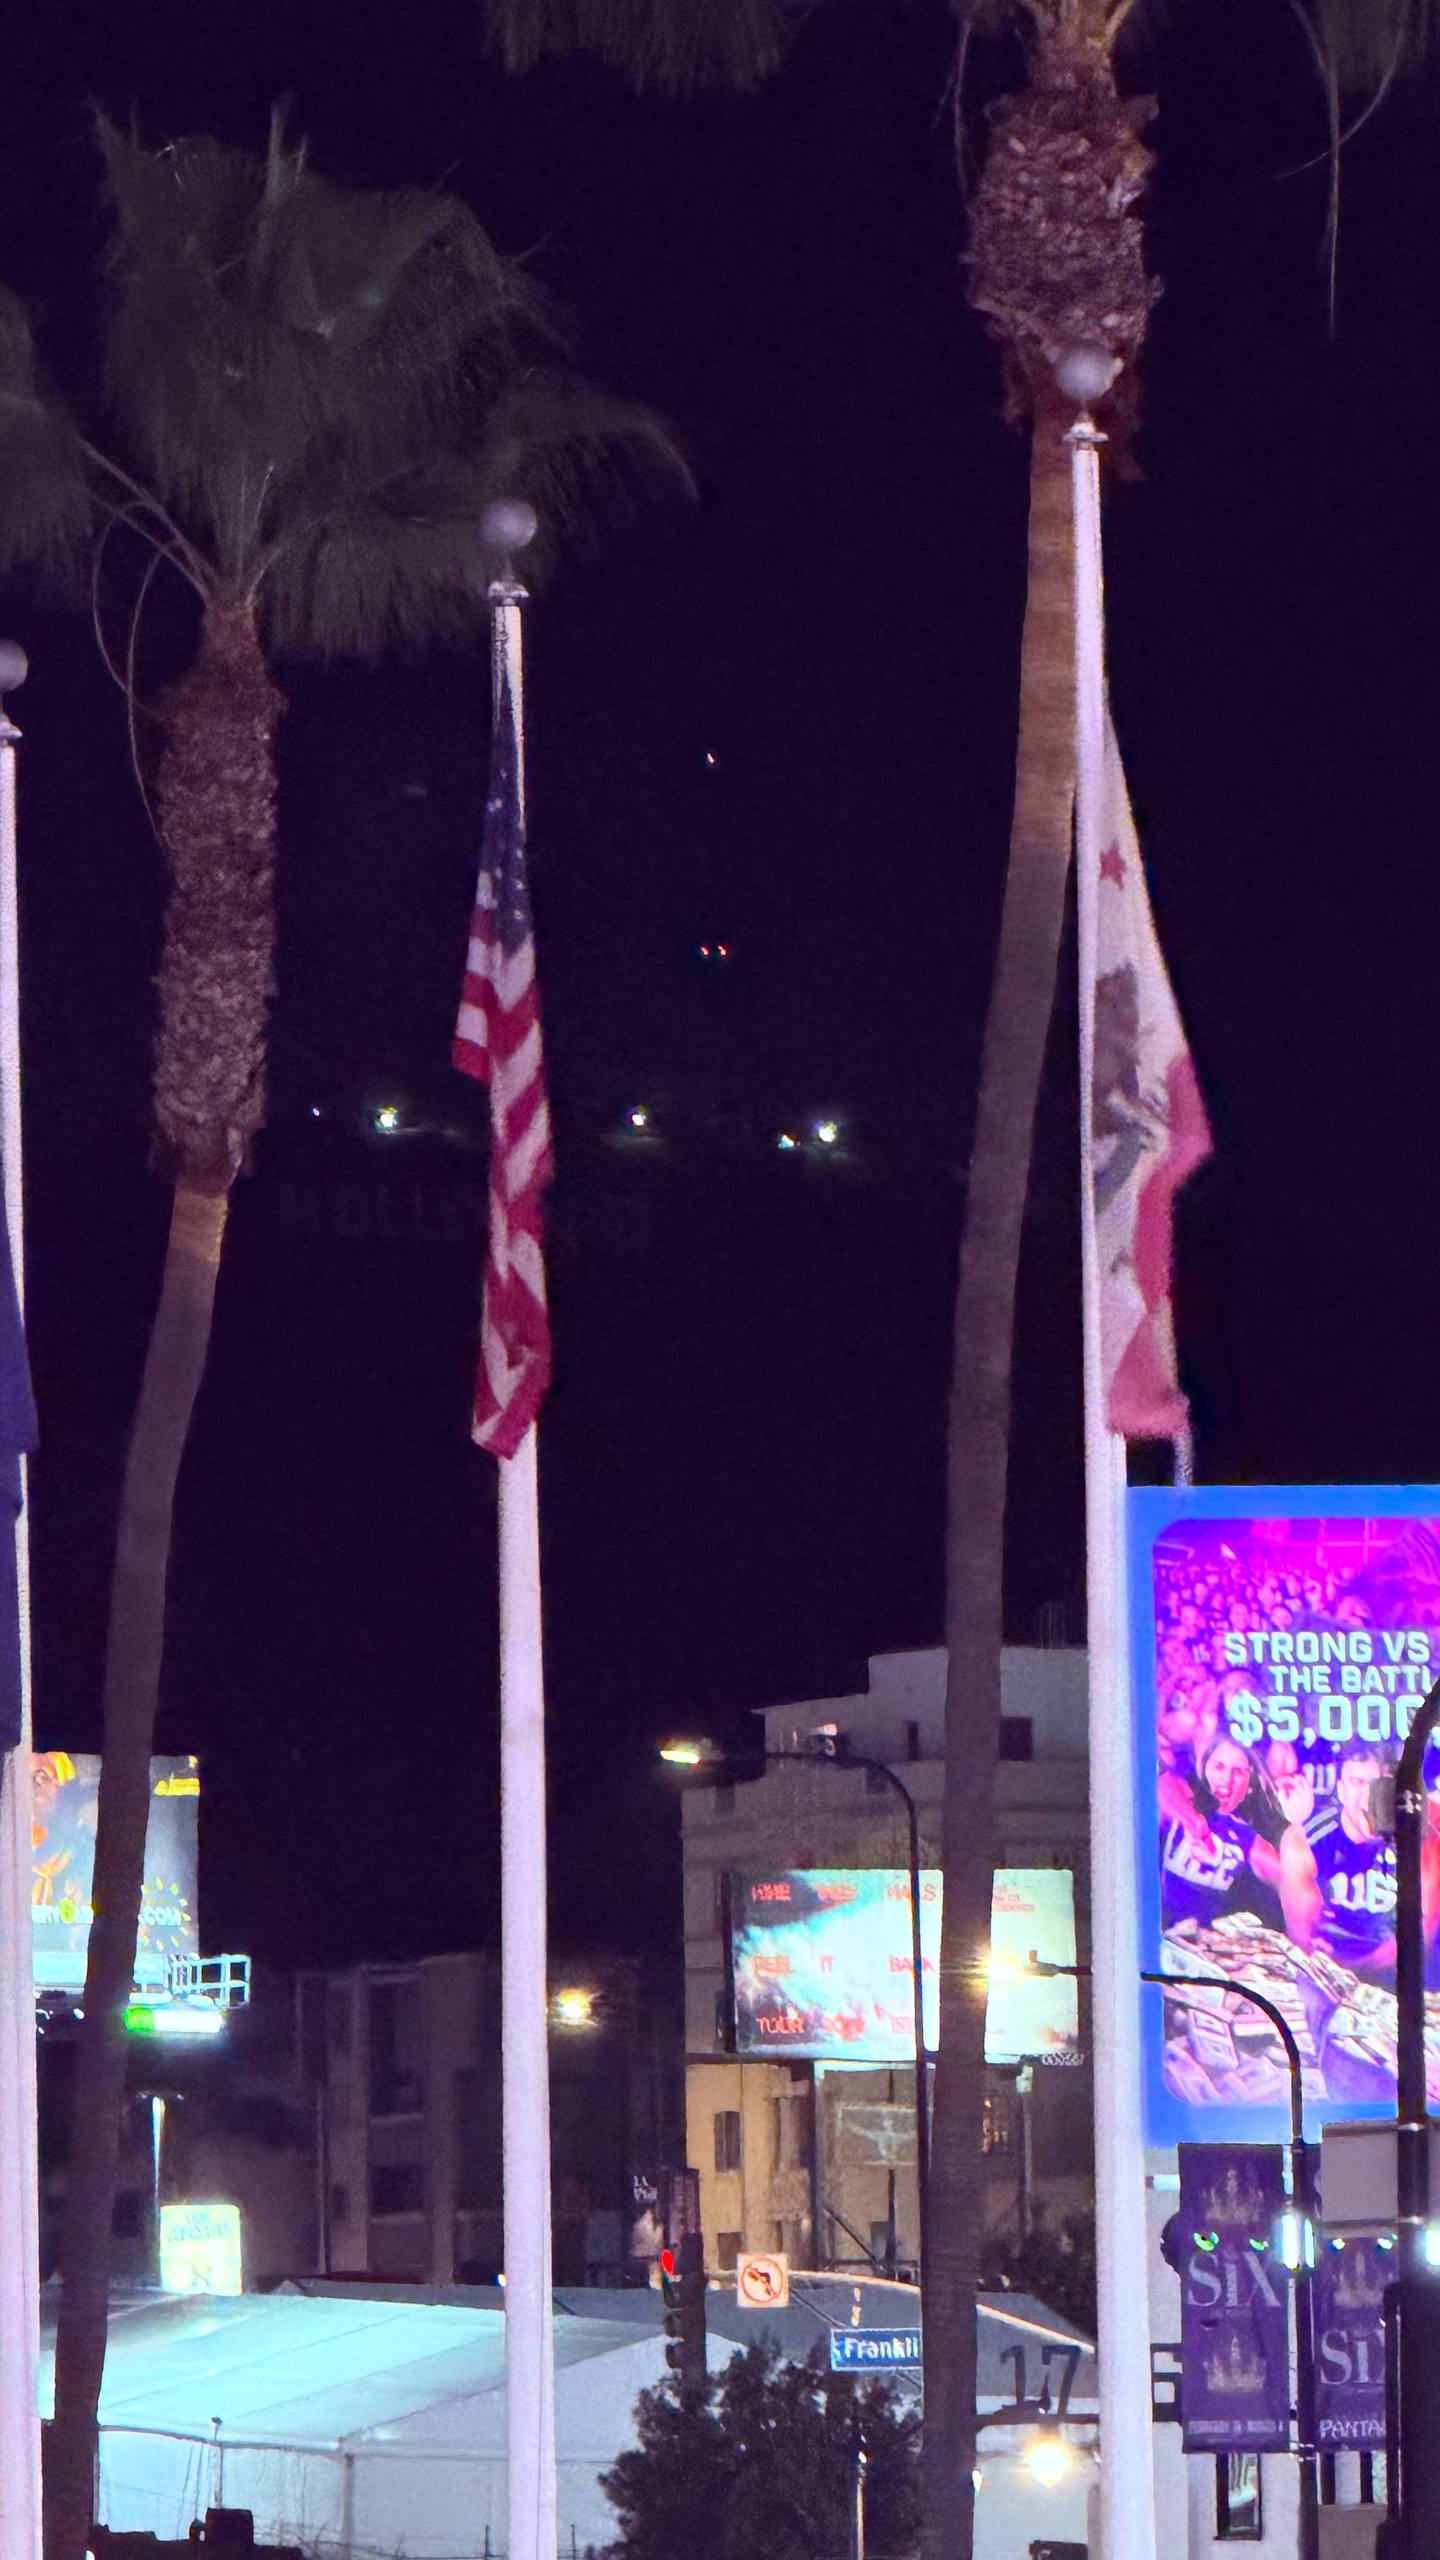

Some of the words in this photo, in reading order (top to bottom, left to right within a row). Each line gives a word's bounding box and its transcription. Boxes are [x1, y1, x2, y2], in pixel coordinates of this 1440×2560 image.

[1224, 1631, 1373, 1664] STRONG
[1382, 1631, 1430, 1663] VS
[1268, 1665, 1332, 1693] THE
[843, 2336, 920, 2359] Frankli
[1318, 2418, 1386, 2439] PANTA
